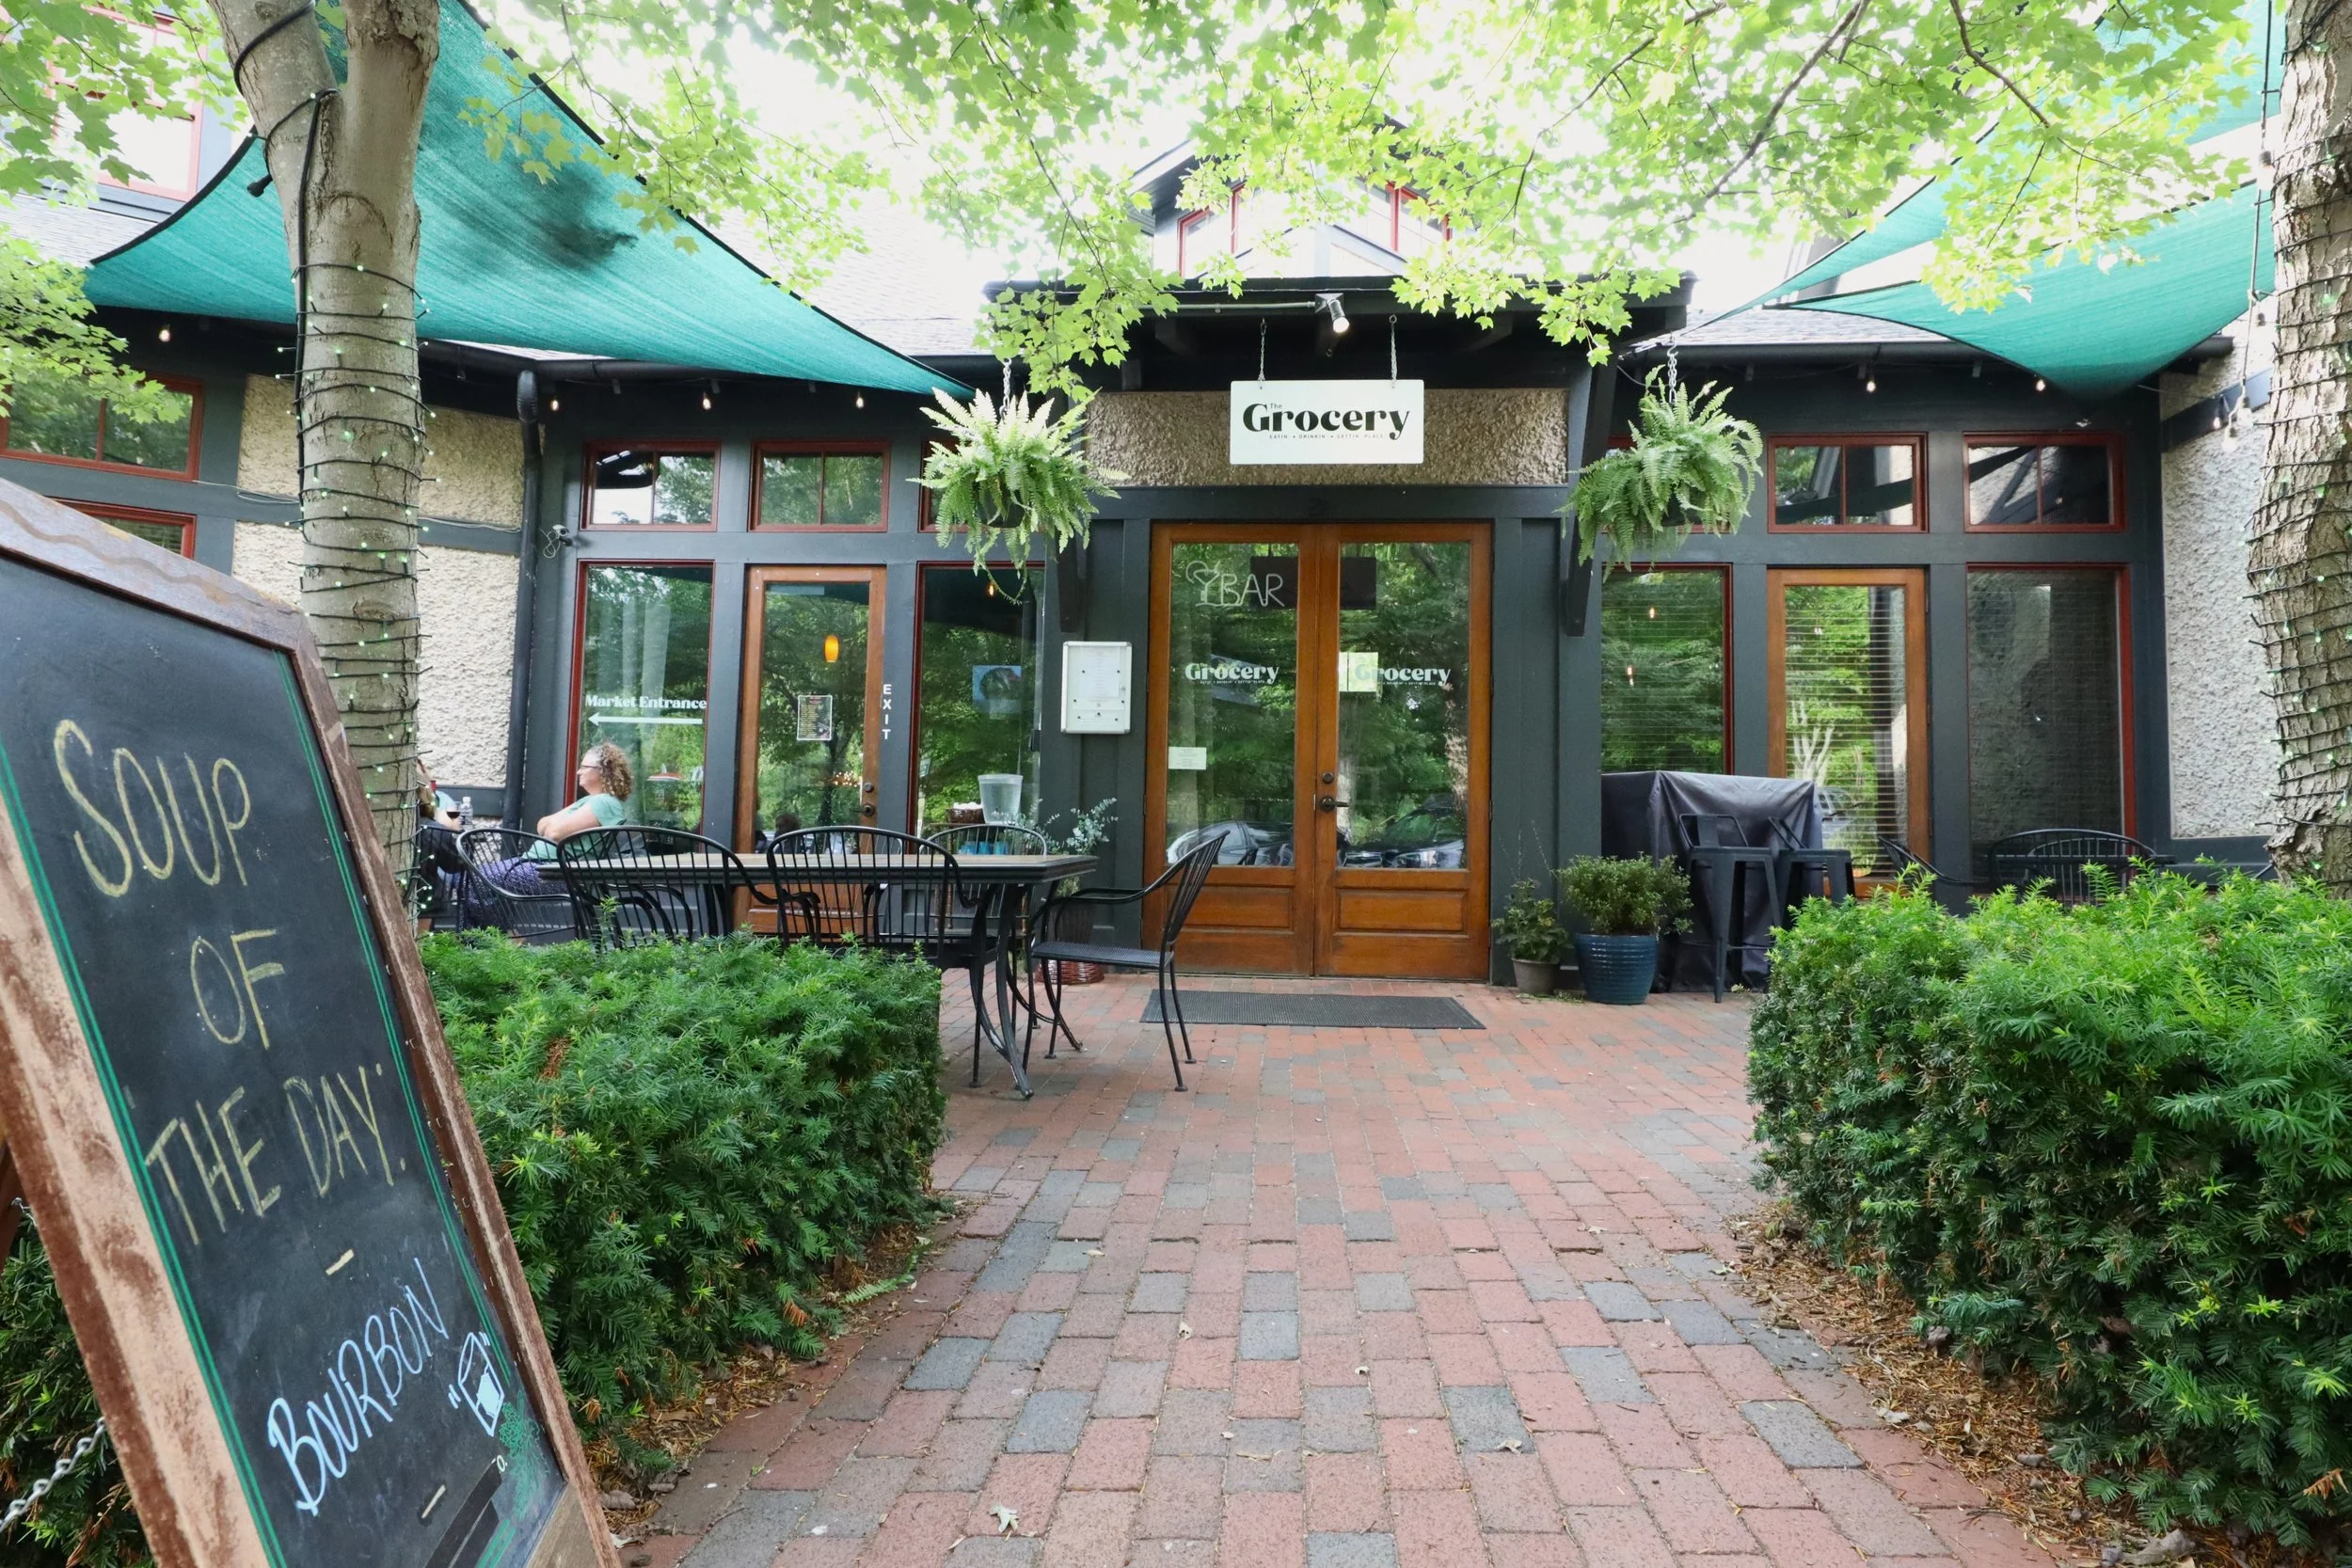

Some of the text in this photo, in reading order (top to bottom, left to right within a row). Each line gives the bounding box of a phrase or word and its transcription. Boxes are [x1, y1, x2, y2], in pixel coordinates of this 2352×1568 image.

[1243, 403, 1409, 440] Grocery
[1221, 574, 1285, 607] BAR
[584, 694, 707, 709] Market Entrance
[1184, 662, 1279, 685] Grocery
[882, 684, 892, 740] EXIT
[54, 719, 251, 897] SOUP
[191, 927, 286, 1050] OF
[144, 1085, 282, 1245] THE
[267, 1257, 450, 1518] BOURBON
